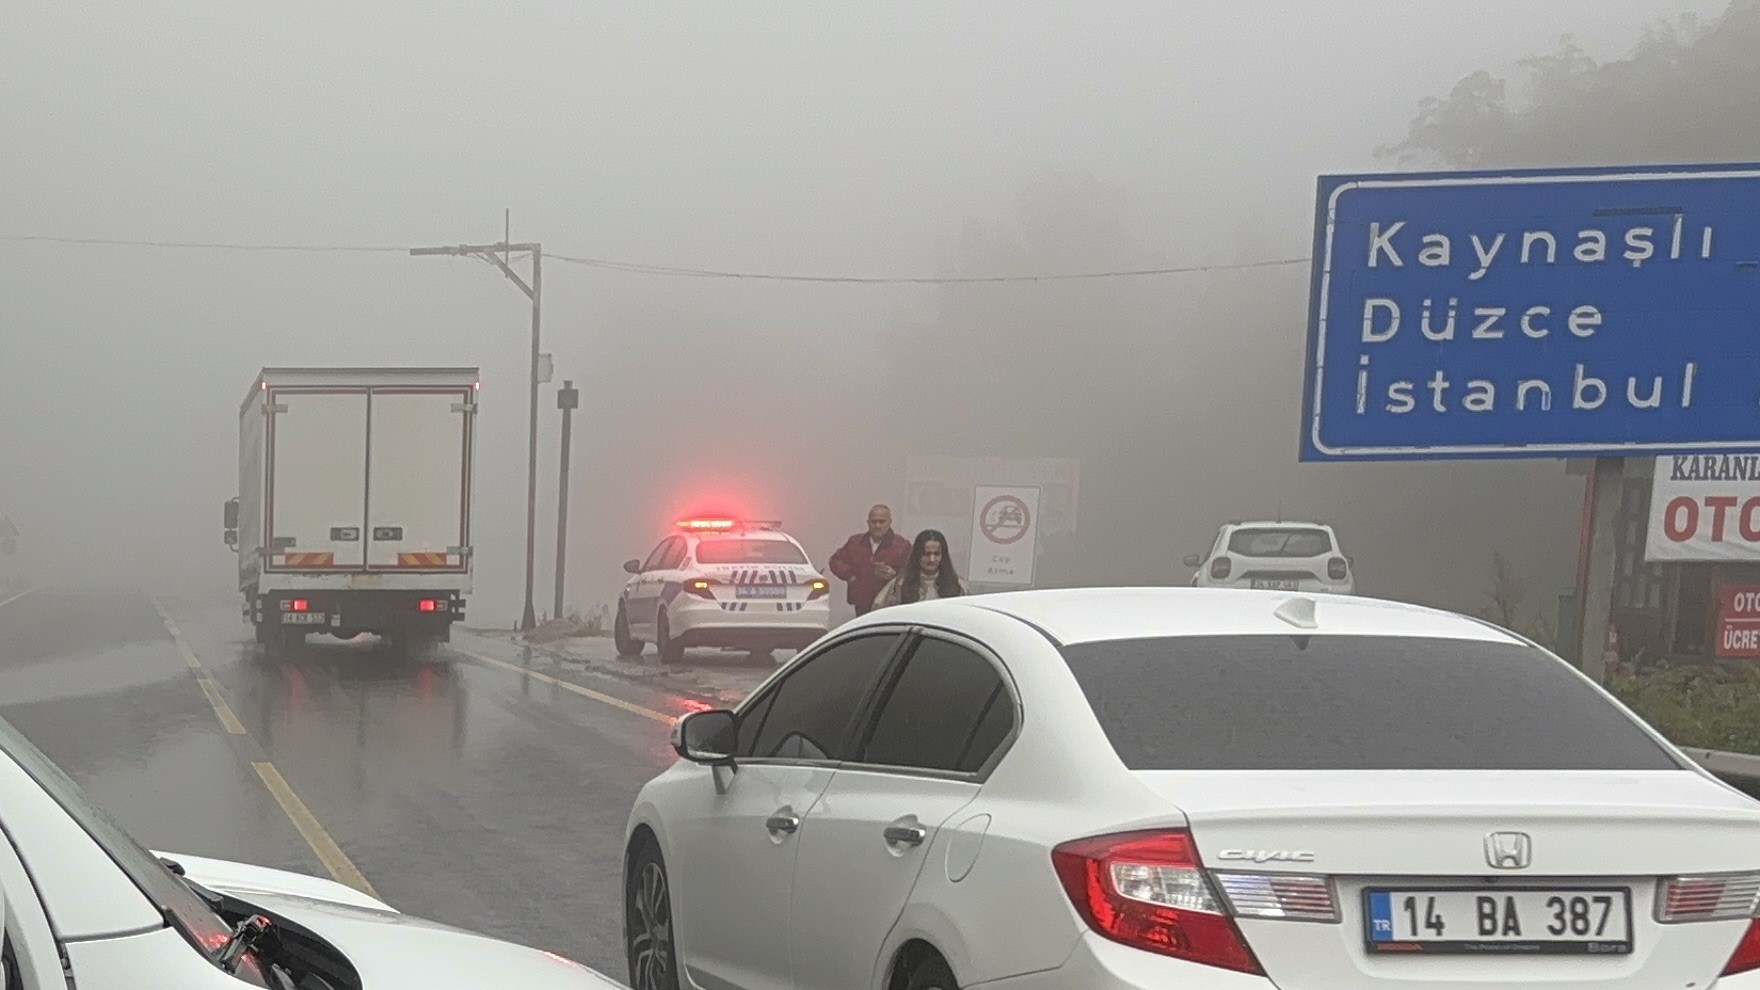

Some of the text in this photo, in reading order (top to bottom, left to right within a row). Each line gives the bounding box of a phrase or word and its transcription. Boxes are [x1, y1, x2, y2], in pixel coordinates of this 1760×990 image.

[1367, 213, 1713, 281] Kaynaşlı
[1360, 297, 1603, 344] Düzce
[1356, 354, 1695, 415] İstanbul
[1723, 624, 1760, 650] ÜCRE
[1373, 919, 1392, 931] TR
[1403, 896, 1613, 937] 14 BA 387
